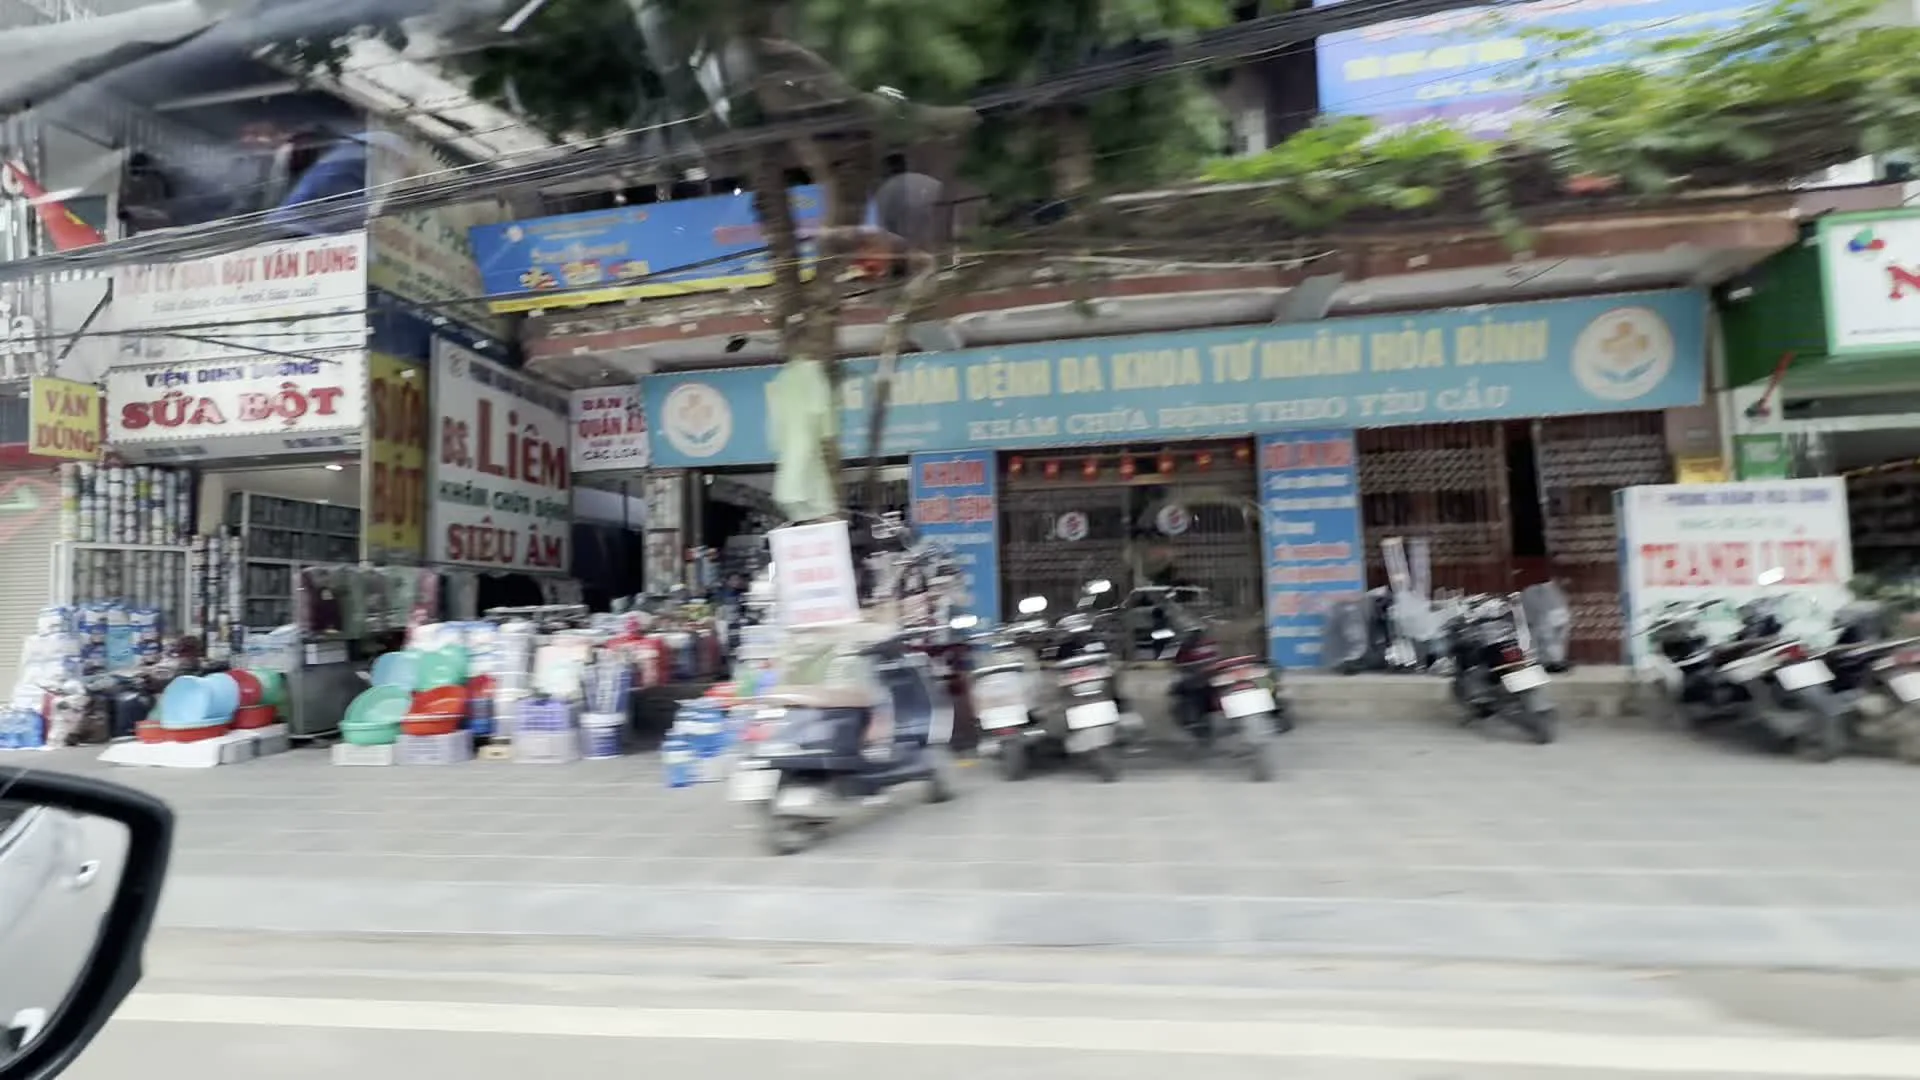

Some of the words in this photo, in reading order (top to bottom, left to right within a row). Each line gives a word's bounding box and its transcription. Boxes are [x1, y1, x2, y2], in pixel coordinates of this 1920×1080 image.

[967, 355, 1051, 406] BỆNH
[1112, 348, 1201, 390] KHOA
[1261, 328, 1362, 379] NHÂN
[1455, 316, 1548, 366] BÌNH
[121, 390, 226, 430] SỮA
[238, 381, 344, 426] BỘT
[968, 412, 1058, 441] KHÁM
[1065, 404, 1150, 435] CHỮA
[1157, 402, 1250, 432] BỆNH
[1254, 397, 1348, 423] THEO
[1356, 388, 1427, 417] YÊU
[1436, 376, 1511, 412] CẦU
[448, 516, 518, 563] SIÊU
[526, 524, 562, 568] ÂM
